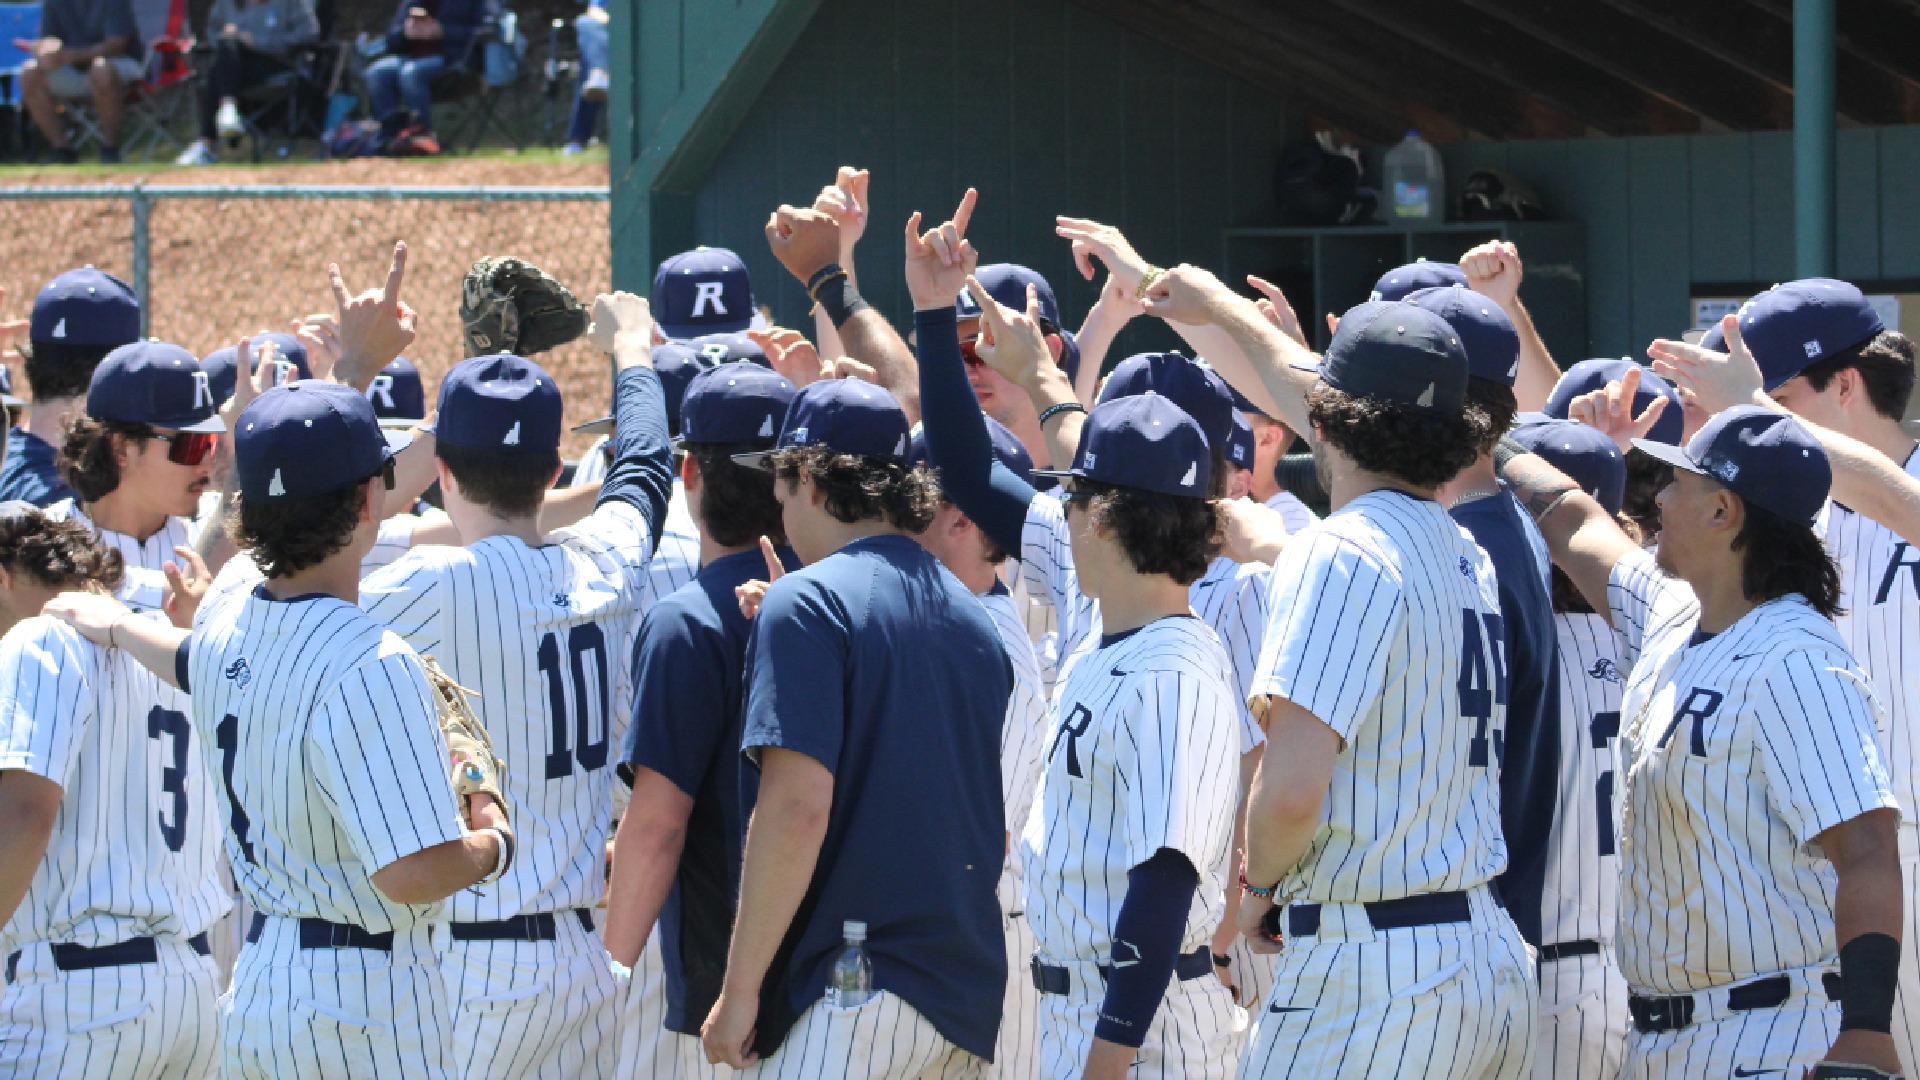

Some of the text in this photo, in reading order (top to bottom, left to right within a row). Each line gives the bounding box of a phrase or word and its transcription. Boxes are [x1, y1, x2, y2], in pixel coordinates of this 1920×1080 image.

[690, 282, 728, 318] R
[191, 371, 214, 410] R
[365, 376, 396, 408] R
[1873, 542, 1920, 606] R
[537, 621, 610, 780] 10
[1656, 686, 1724, 758] R
[1048, 701, 1093, 779] R
[148, 704, 191, 853] 3
[216, 713, 261, 869] 1
